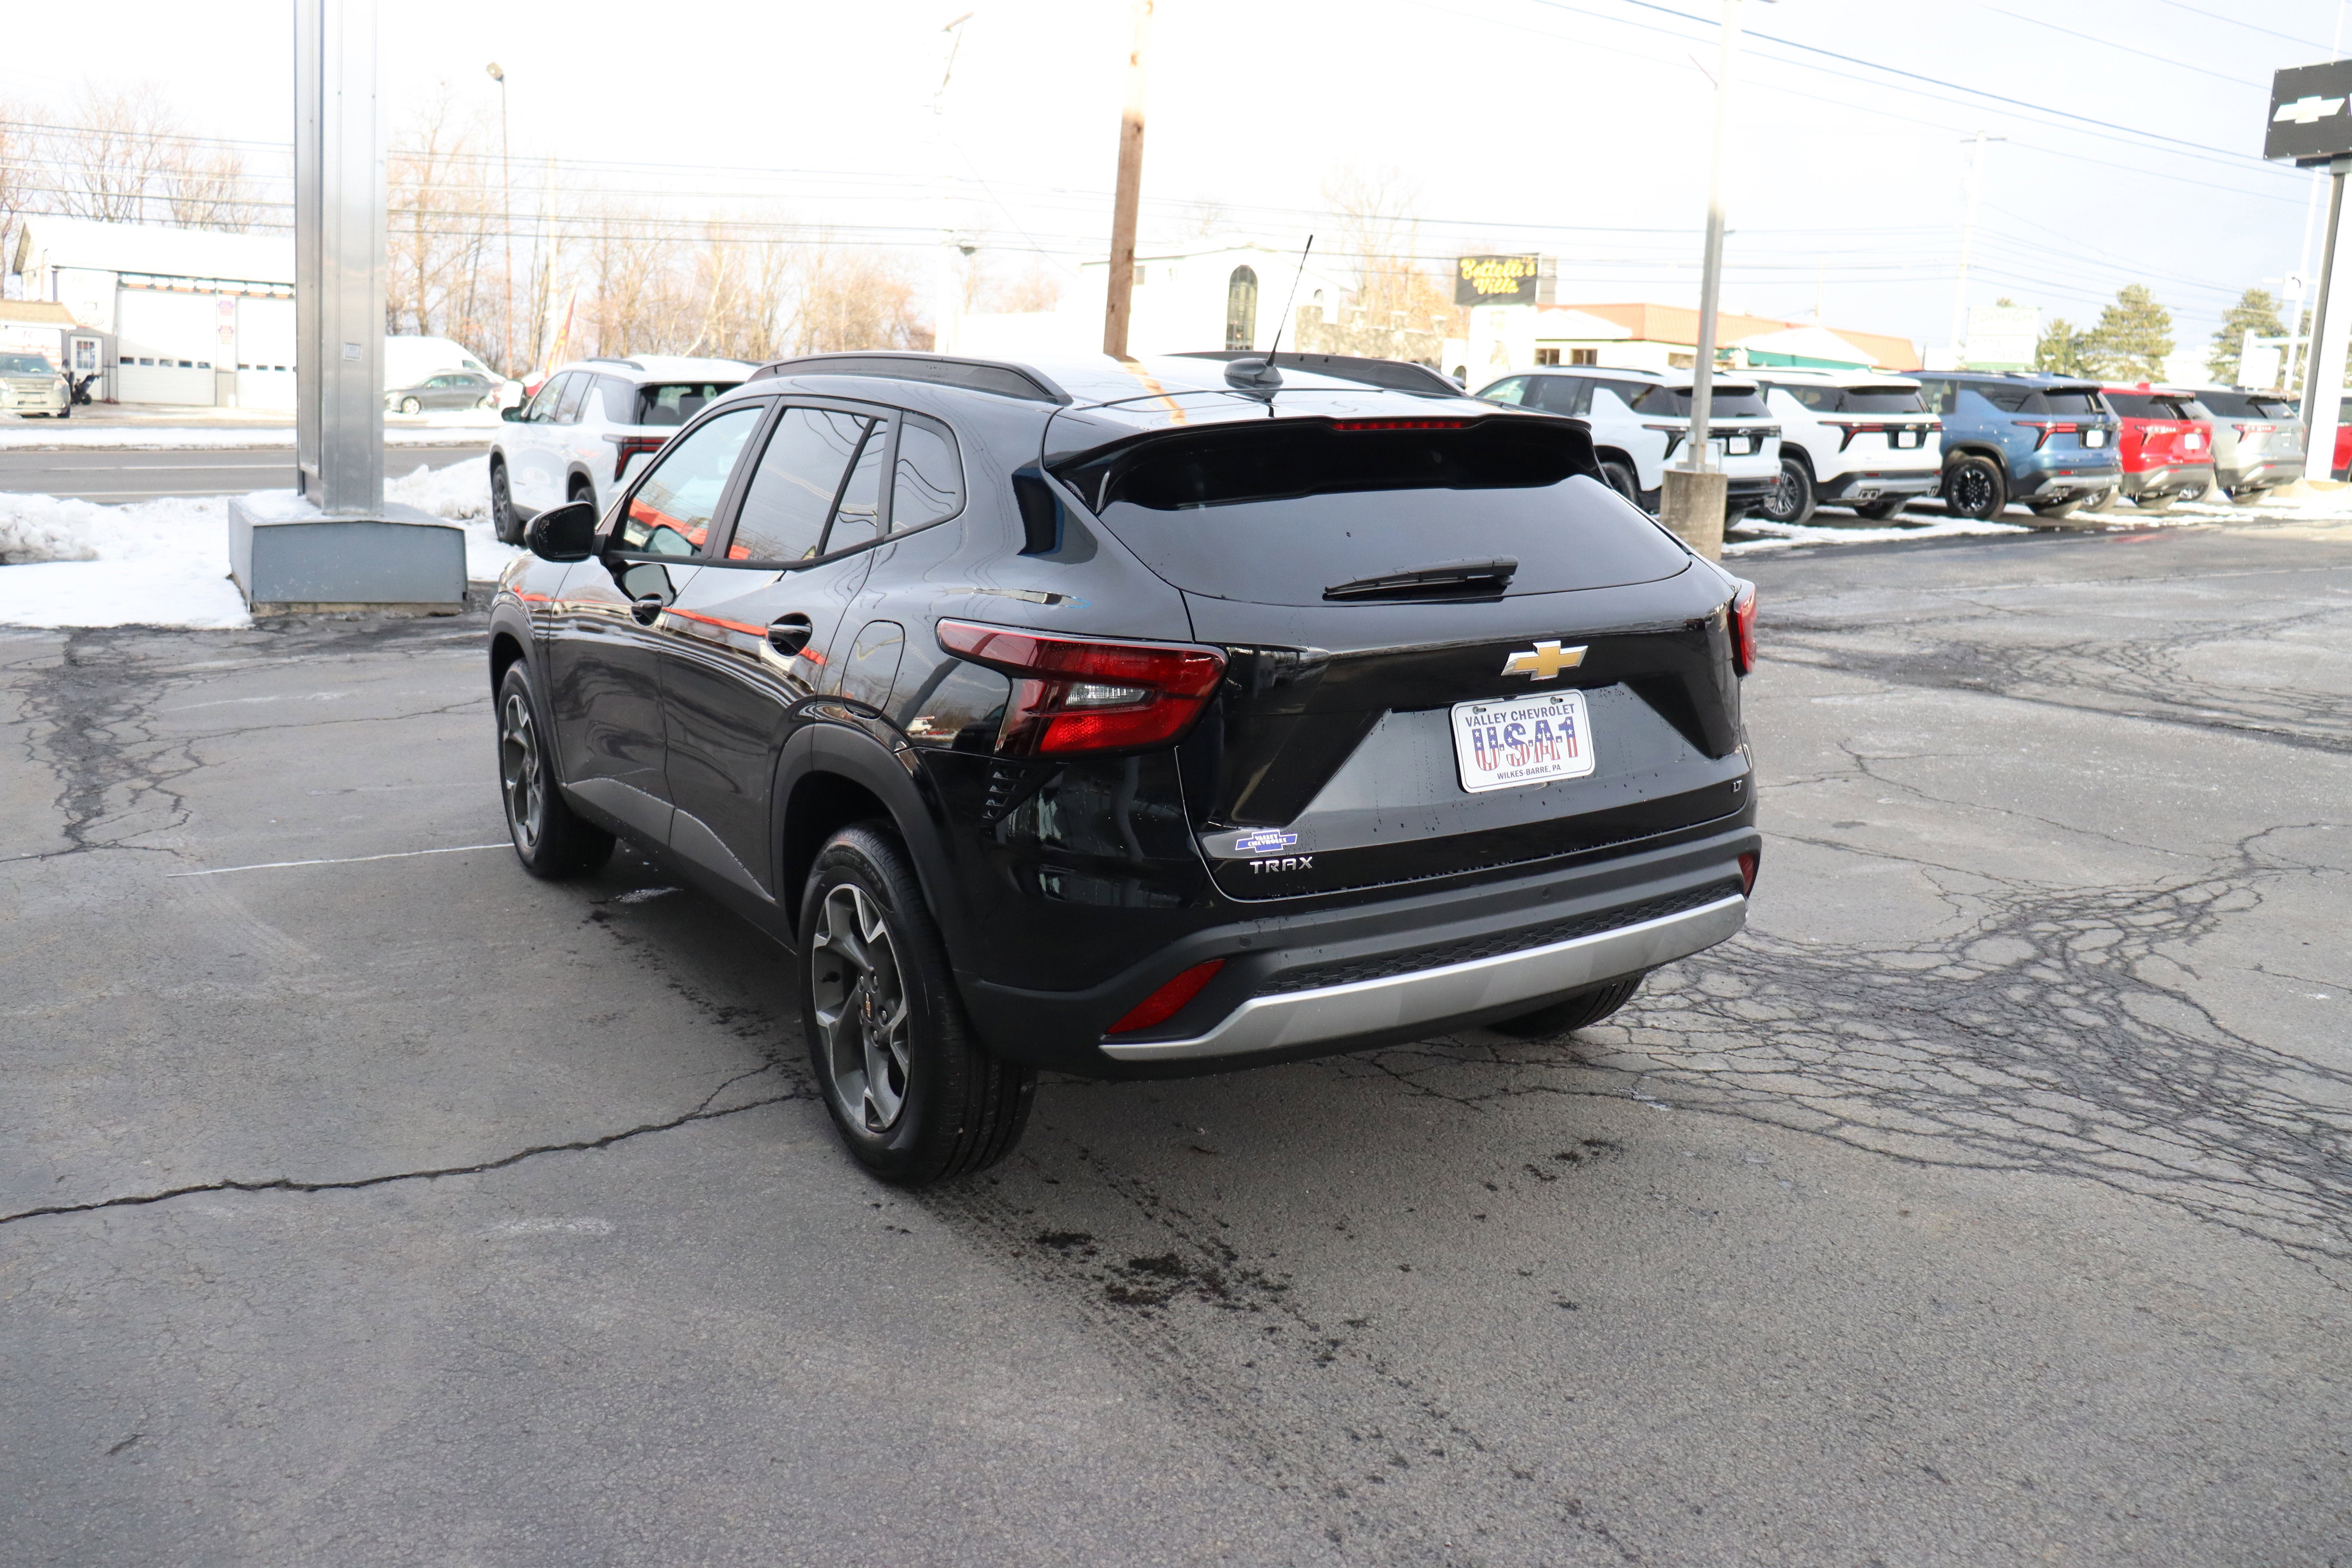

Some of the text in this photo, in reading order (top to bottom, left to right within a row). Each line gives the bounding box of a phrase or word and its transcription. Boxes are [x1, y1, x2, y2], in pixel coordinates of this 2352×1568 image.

[1472, 277, 1519, 295] Villa
[1465, 704, 1575, 727] VALLEY CHEVROLET
[1497, 766, 1551, 780] WILKES-BARRE,
[1247, 837, 1287, 846] CHEVROLET
[1250, 856, 1313, 874] TRAX
